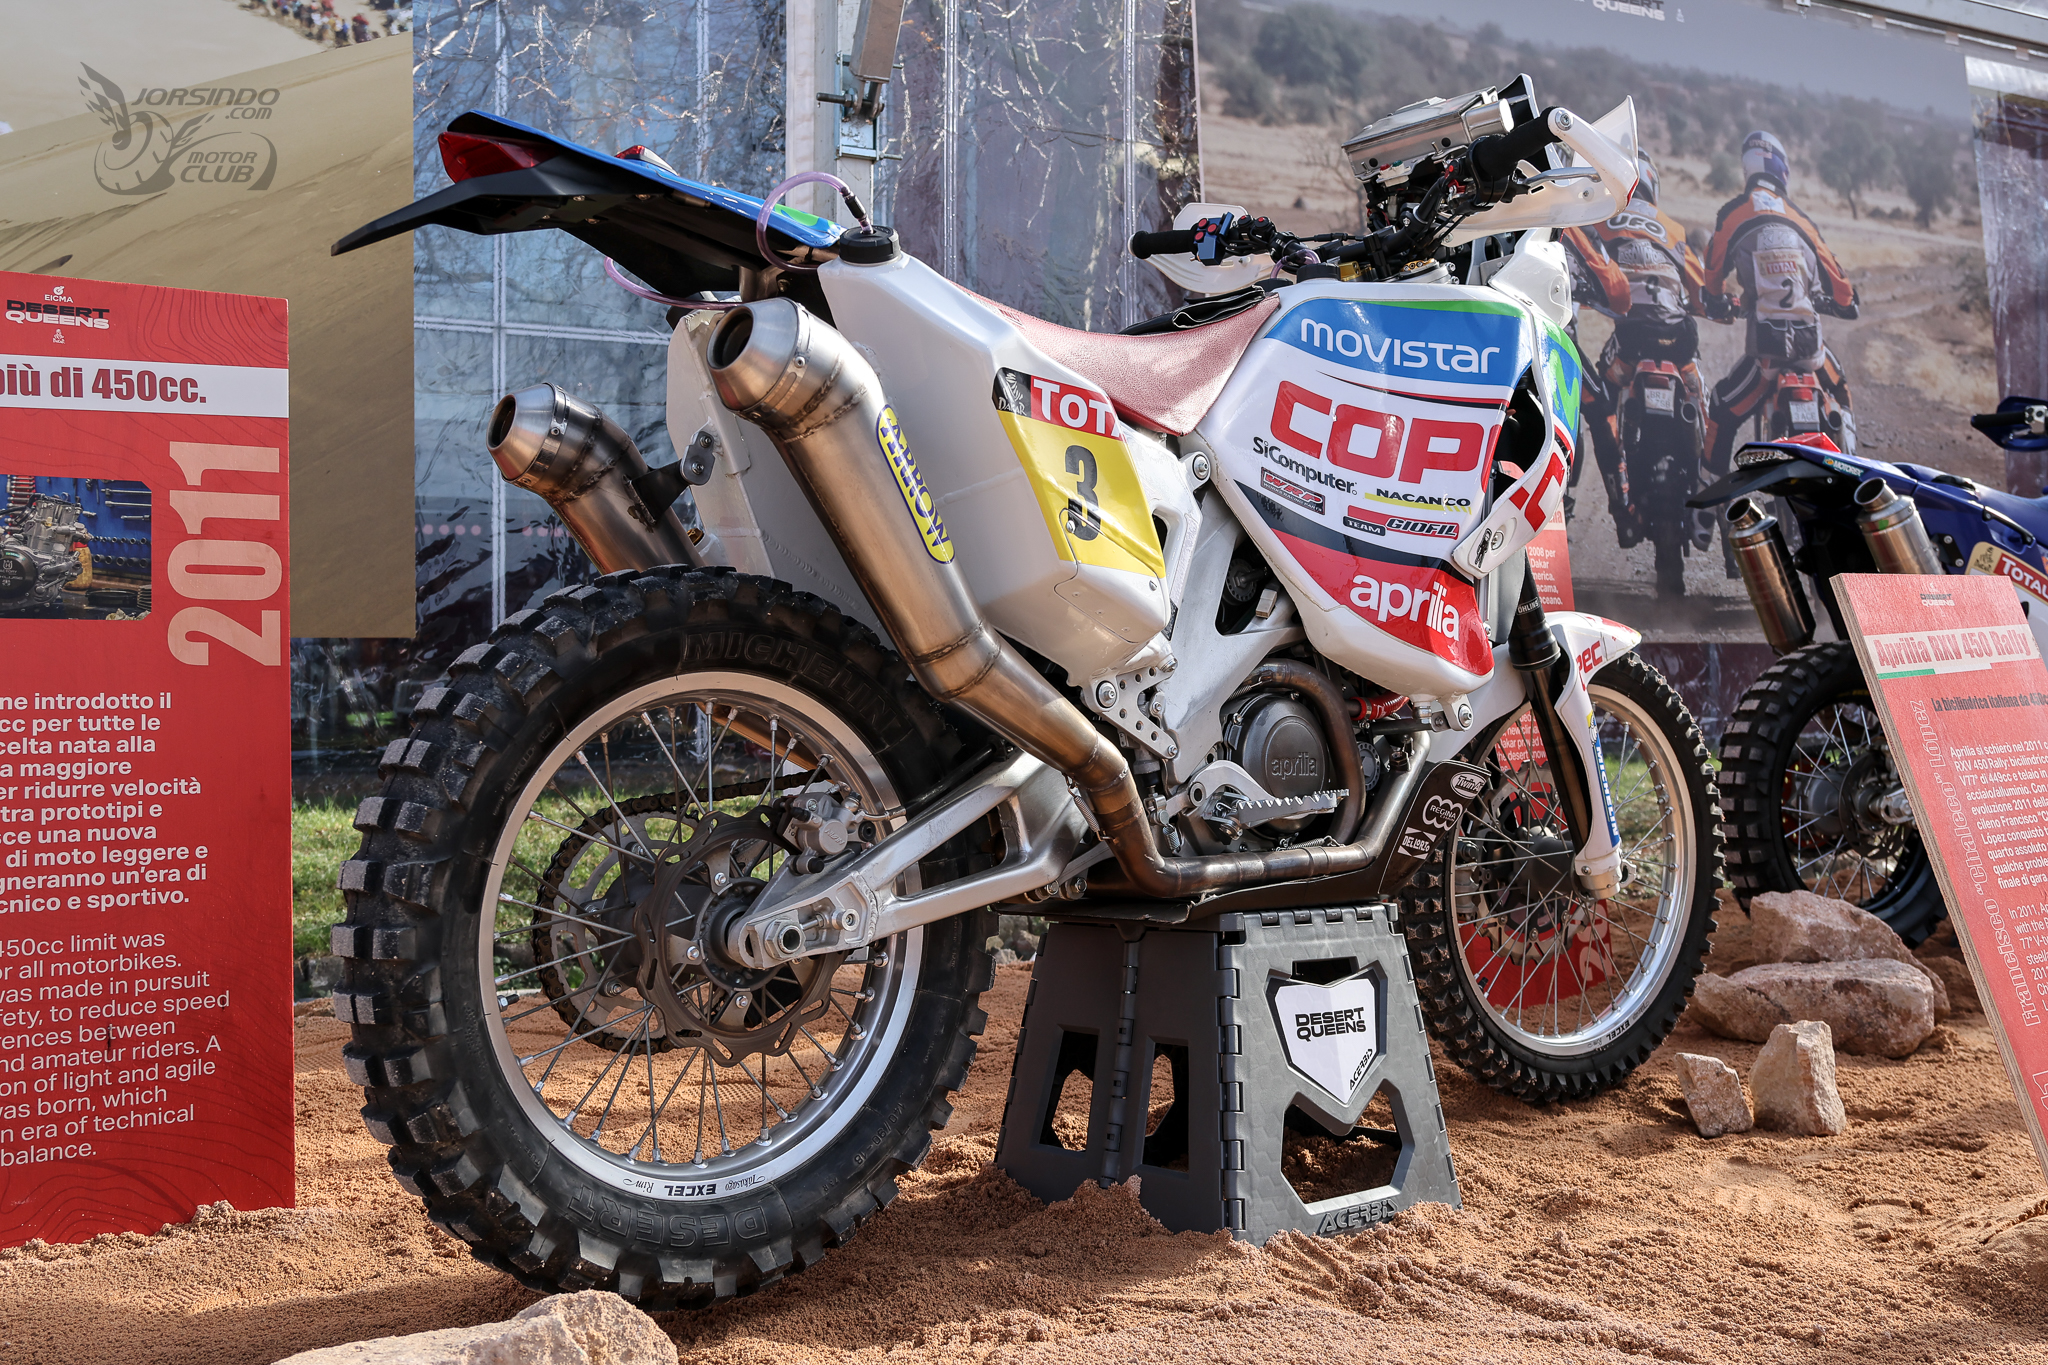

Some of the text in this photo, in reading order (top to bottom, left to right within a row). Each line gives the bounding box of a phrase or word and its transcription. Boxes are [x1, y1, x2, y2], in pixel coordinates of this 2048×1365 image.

[1607, 212, 1667, 242] UFO
[1767, 261, 1796, 274] TOTAL
[44, 294, 73, 303] EICMA
[1779, 279, 1793, 308] 2
[5, 310, 110, 329] QUEENS
[7, 300, 110, 318] DESERT
[1301, 318, 1500, 374] movistar
[0, 363, 207, 403] iù di 450cc.
[1034, 378, 1123, 438] TOT
[1270, 380, 1484, 484] COP
[880, 415, 950, 547] ARROW
[1264, 472, 1323, 505] WRP
[1065, 444, 1101, 541] 3
[1376, 488, 1471, 507] NACANCO
[1348, 517, 1458, 538] TEAM GIOFIL
[167, 441, 282, 666] 2011
[1350, 573, 1459, 642] aprilia
[1873, 629, 2031, 668] Aprilia RXV 450 Rally
[684, 632, 898, 732] MICHELIN
[35, 692, 154, 711] introdotto
[160, 692, 172, 709] il
[1931, 693, 2030, 712] La bicilindrica italiana da
[32, 717, 72, 736] per
[78, 715, 135, 732] tutte
[141, 714, 161, 731] le
[59, 735, 156, 754] nata alla
[1950, 740, 2043, 759] Aprilia si schierò nel 2011
[20, 758, 132, 780] maggiore
[1271, 752, 1318, 777] aprilia
[1954, 759, 1989, 772] RXV 450
[1980, 773, 1989, 784] di
[1989, 772, 2012, 784] 449cc
[2018, 769, 2040, 781] telaio
[24, 777, 201, 799] ridurre velocità
[1596, 746, 1620, 837] MICHELIN
[2031, 783, 2047, 794] Con
[41, 801, 143, 825] prototipi
[149, 802, 163, 817] e
[1430, 804, 1457, 820] REGINA
[1972, 798, 2032, 815] evoluzione 2011
[1977, 818, 2001, 830] cileno
[2000, 813, 2039, 827] Francisco
[38, 825, 157, 844] una nuova
[1981, 826, 2045, 846] López conquistò
[6, 845, 208, 868] di moto leggere e
[1987, 842, 2047, 862] quarto assoluto
[186, 863, 207, 881] di
[1993, 860, 2024, 876] qualche
[1998, 876, 2021, 889] finale
[2021, 874, 2030, 886] di
[67, 888, 189, 912] e sportivo.
[2008, 908, 2018, 919] In
[2014, 919, 2045, 934] with the
[71, 933, 117, 953] limit
[122, 932, 165, 949] was
[19, 960, 43, 980] all
[51, 953, 182, 977] motorbikes.
[1984, 898, 2041, 1026] Francisco
[39, 971, 210, 1001] made in pursuit
[50, 990, 230, 1023] to reduce speed
[1295, 1007, 1364, 1027] DESERT
[79, 1020, 175, 1044] between
[1296, 1019, 1367, 1042] QUEENS
[1606, 1020, 1630, 1040] EXCEL
[31, 1035, 221, 1070] amateur riders. A
[34, 1073, 57, 1093] of
[64, 1069, 112, 1093] light
[118, 1063, 159, 1083] and
[165, 1059, 216, 1081] agile
[38, 1085, 167, 1117] born, which
[21, 1104, 195, 1140] era of technical
[0, 1142, 97, 1167] balance.
[664, 1183, 717, 1197] EXCEL
[568, 1185, 769, 1248] DESERT
